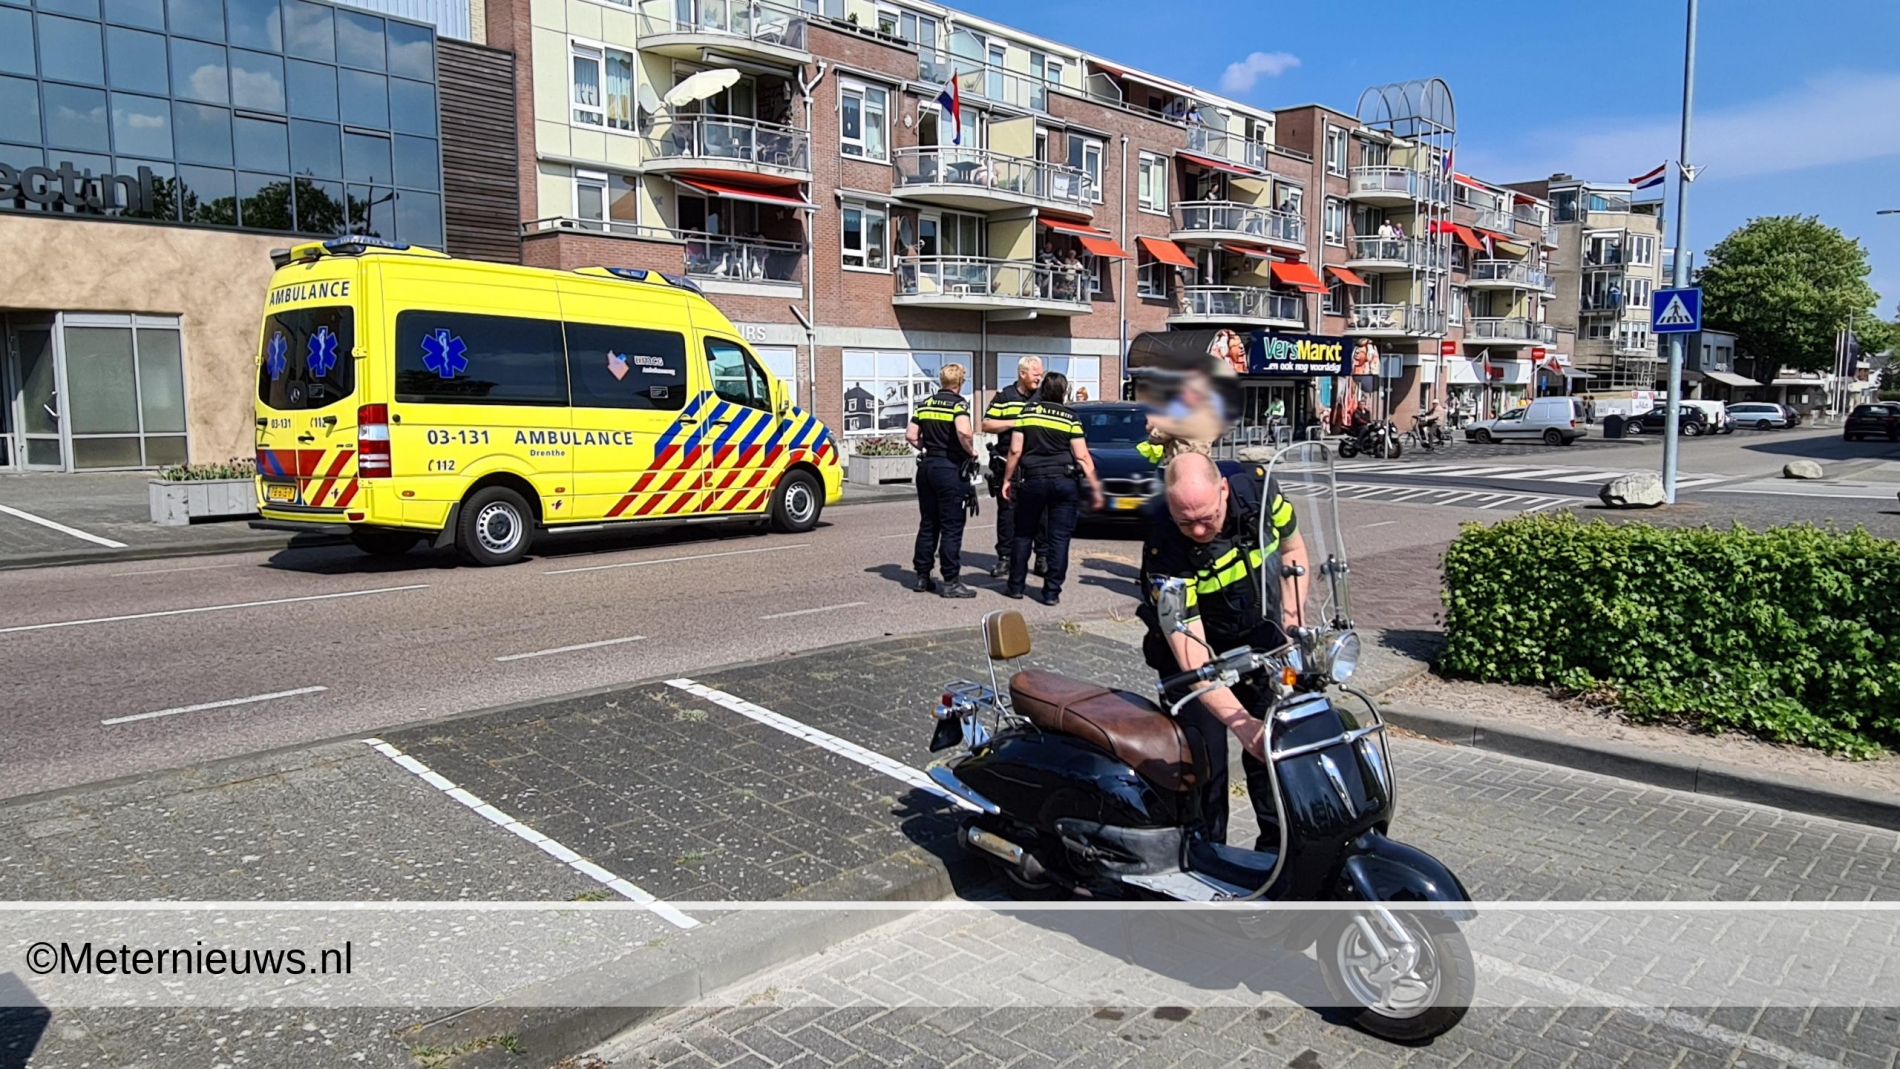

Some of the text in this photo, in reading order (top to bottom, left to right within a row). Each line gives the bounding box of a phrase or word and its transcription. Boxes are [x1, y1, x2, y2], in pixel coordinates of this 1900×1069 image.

[268, 280, 351, 307] AMBULANCE
[1263, 336, 1342, 361] VersMarkt
[1280, 361, 1294, 371] ook
[1294, 362, 1309, 373] nog
[271, 418, 291, 429] 03-131
[427, 429, 490, 445] 03-131
[514, 430, 634, 446] AMBULANCE
[529, 449, 566, 457] Drenthe
[436, 460, 455, 471] 112
